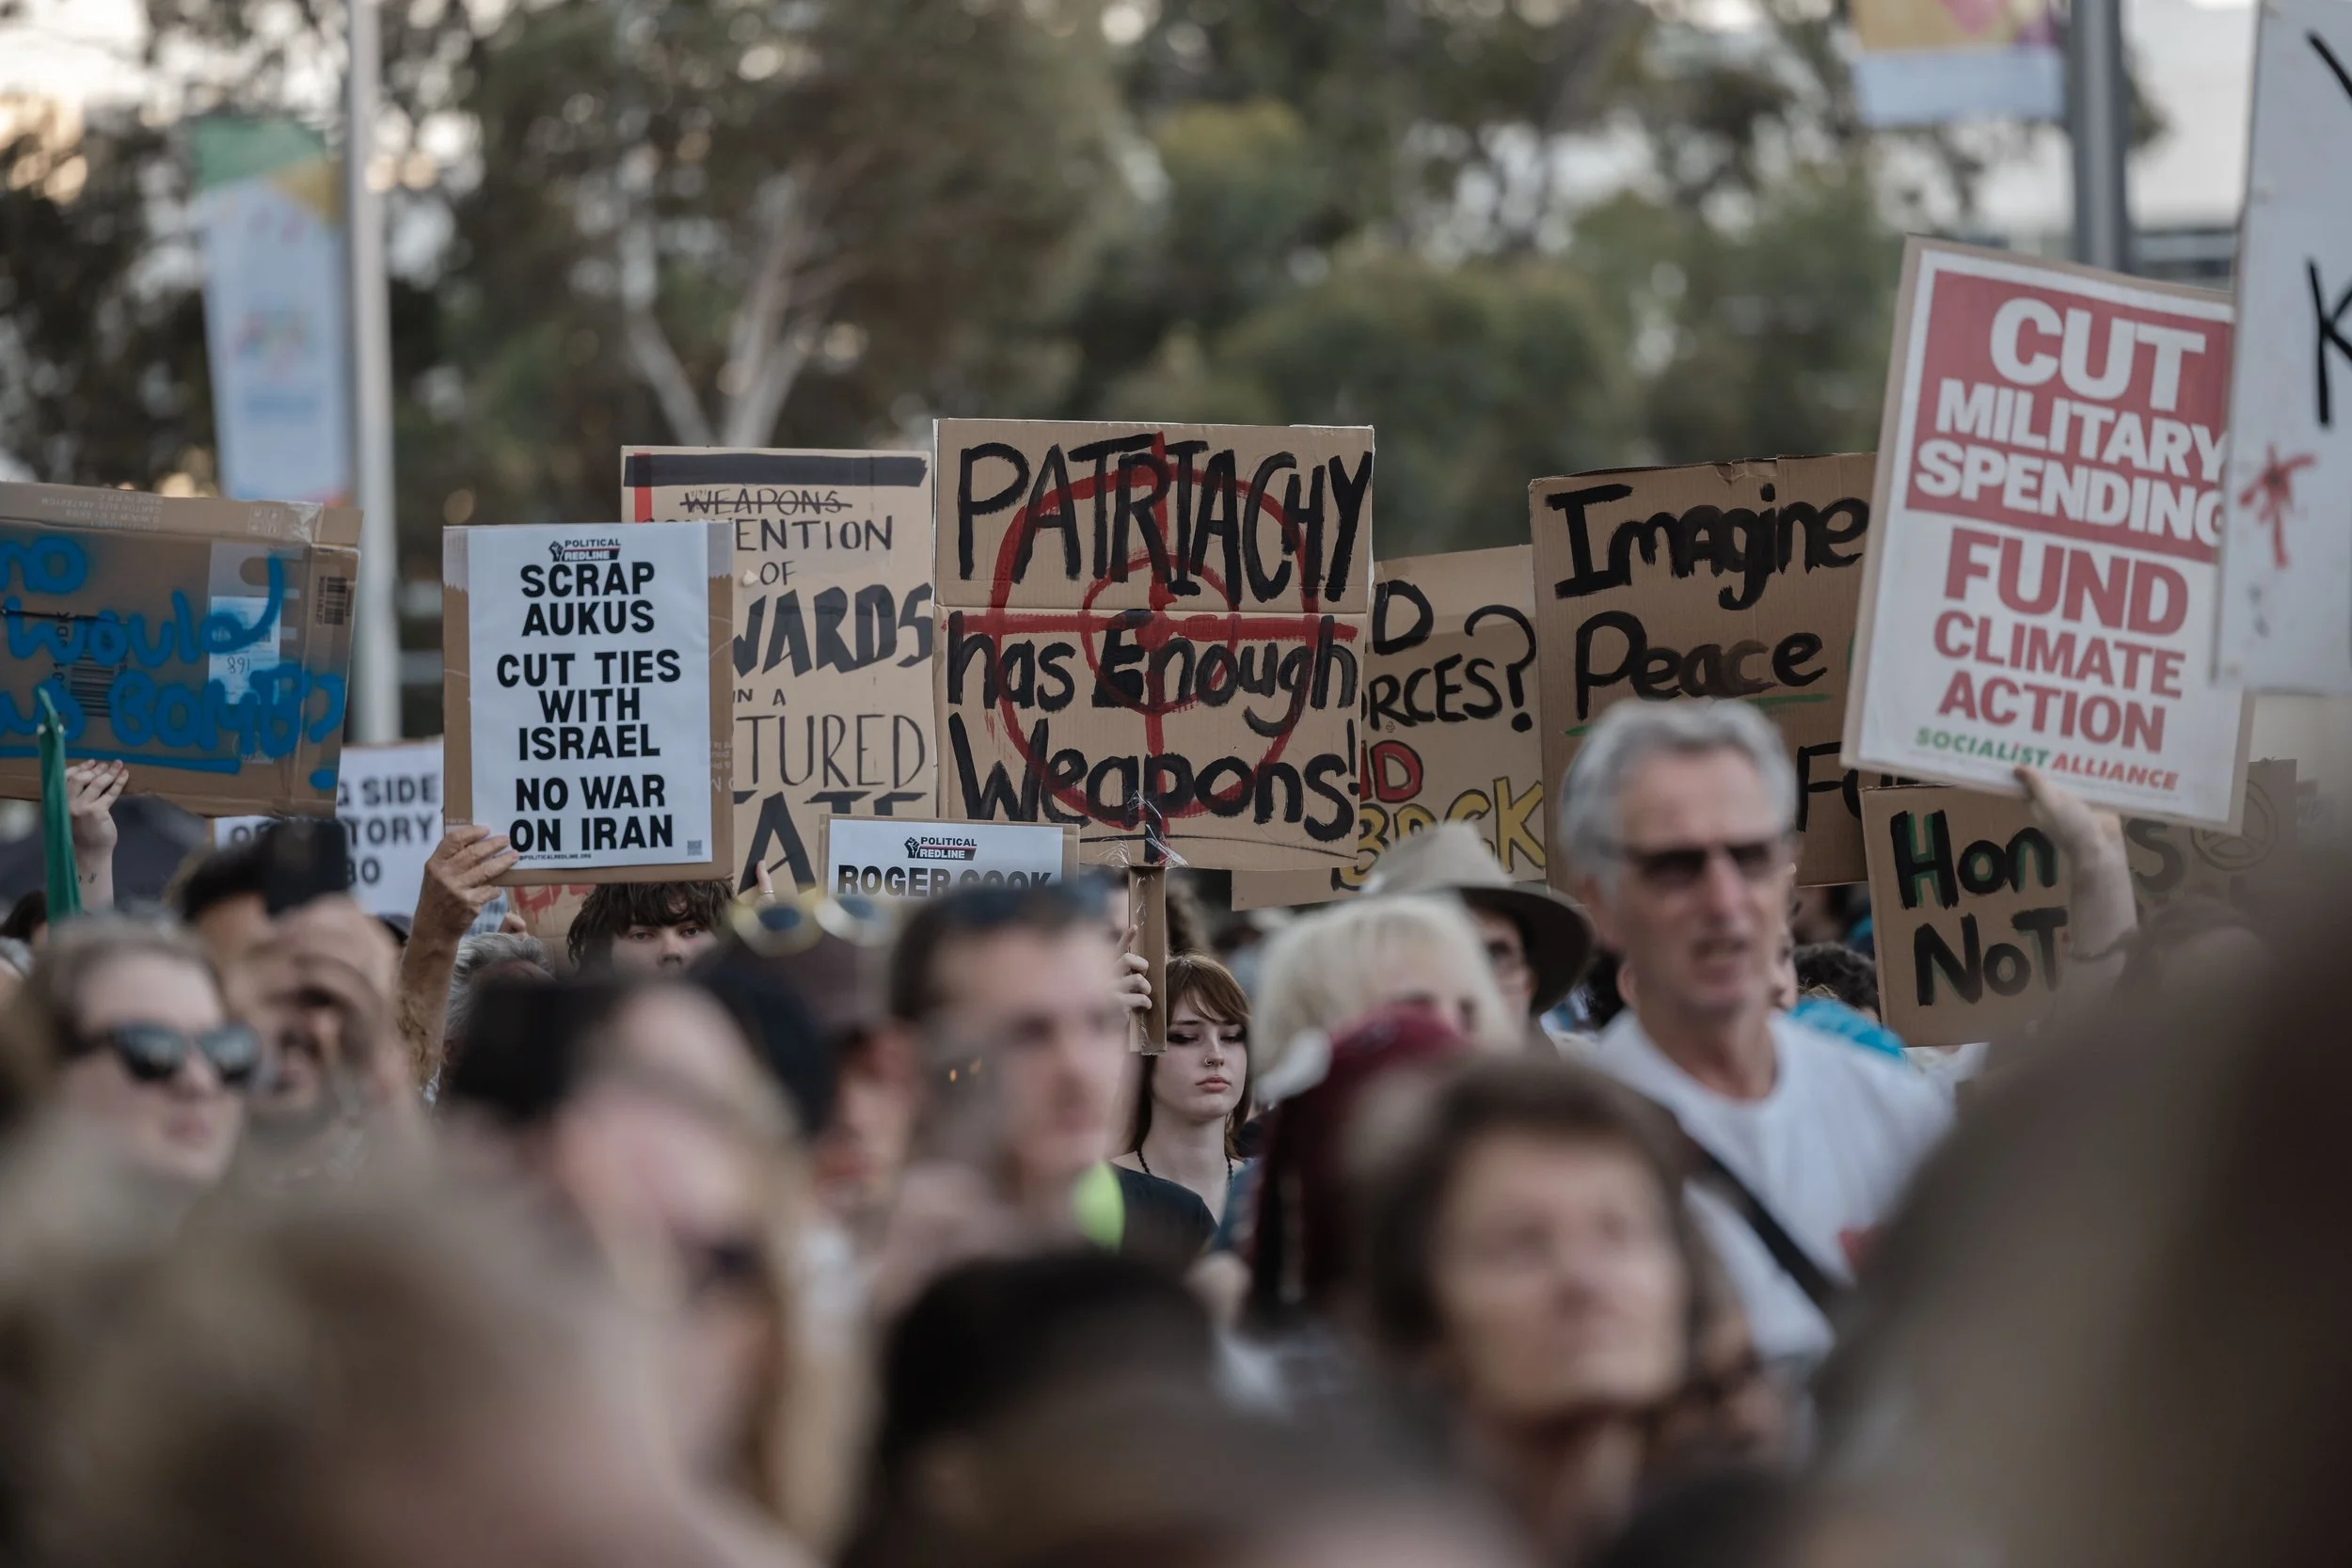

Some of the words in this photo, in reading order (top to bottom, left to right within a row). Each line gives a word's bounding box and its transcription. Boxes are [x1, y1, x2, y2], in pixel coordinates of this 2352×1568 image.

[1990, 297, 2205, 412] CUT
[1935, 378, 2227, 483] MILITARY
[681, 488, 850, 515] WEAPONS
[958, 434, 1373, 603] PATRIACHY
[564, 538, 620, 547] POLITICAL
[564, 550, 611, 560] REDLINE
[520, 562, 655, 597] SCRAP
[759, 561, 797, 586] OF
[1944, 528, 2188, 637] FUND
[521, 600, 655, 637] AUKUS
[497, 653, 576, 688] CUT
[595, 649, 681, 685] TIES
[947, 610, 1075, 712] has
[1092, 609, 1358, 737] Enough
[1575, 610, 1829, 721] Peace
[1932, 610, 2186, 700] CLIMATE
[538, 687, 640, 723] WITH
[772, 689, 787, 705] A
[1937, 670, 2166, 753] ACTION
[519, 724, 660, 761] ISRAEL
[736, 714, 926, 789] TURED
[363, 773, 438, 807] SIDE
[2051, 752, 2180, 792] ALLIANCE
[516, 777, 568, 811] NO
[580, 774, 665, 809] WAR
[343, 816, 435, 846] TORY
[509, 818, 561, 852] ON
[581, 815, 674, 851] IRAN
[920, 836, 977, 847] POLITICAL
[919, 848, 965, 859] REDLINE
[837, 863, 950, 896] ROGER
[1914, 907, 2069, 1007] NoT
